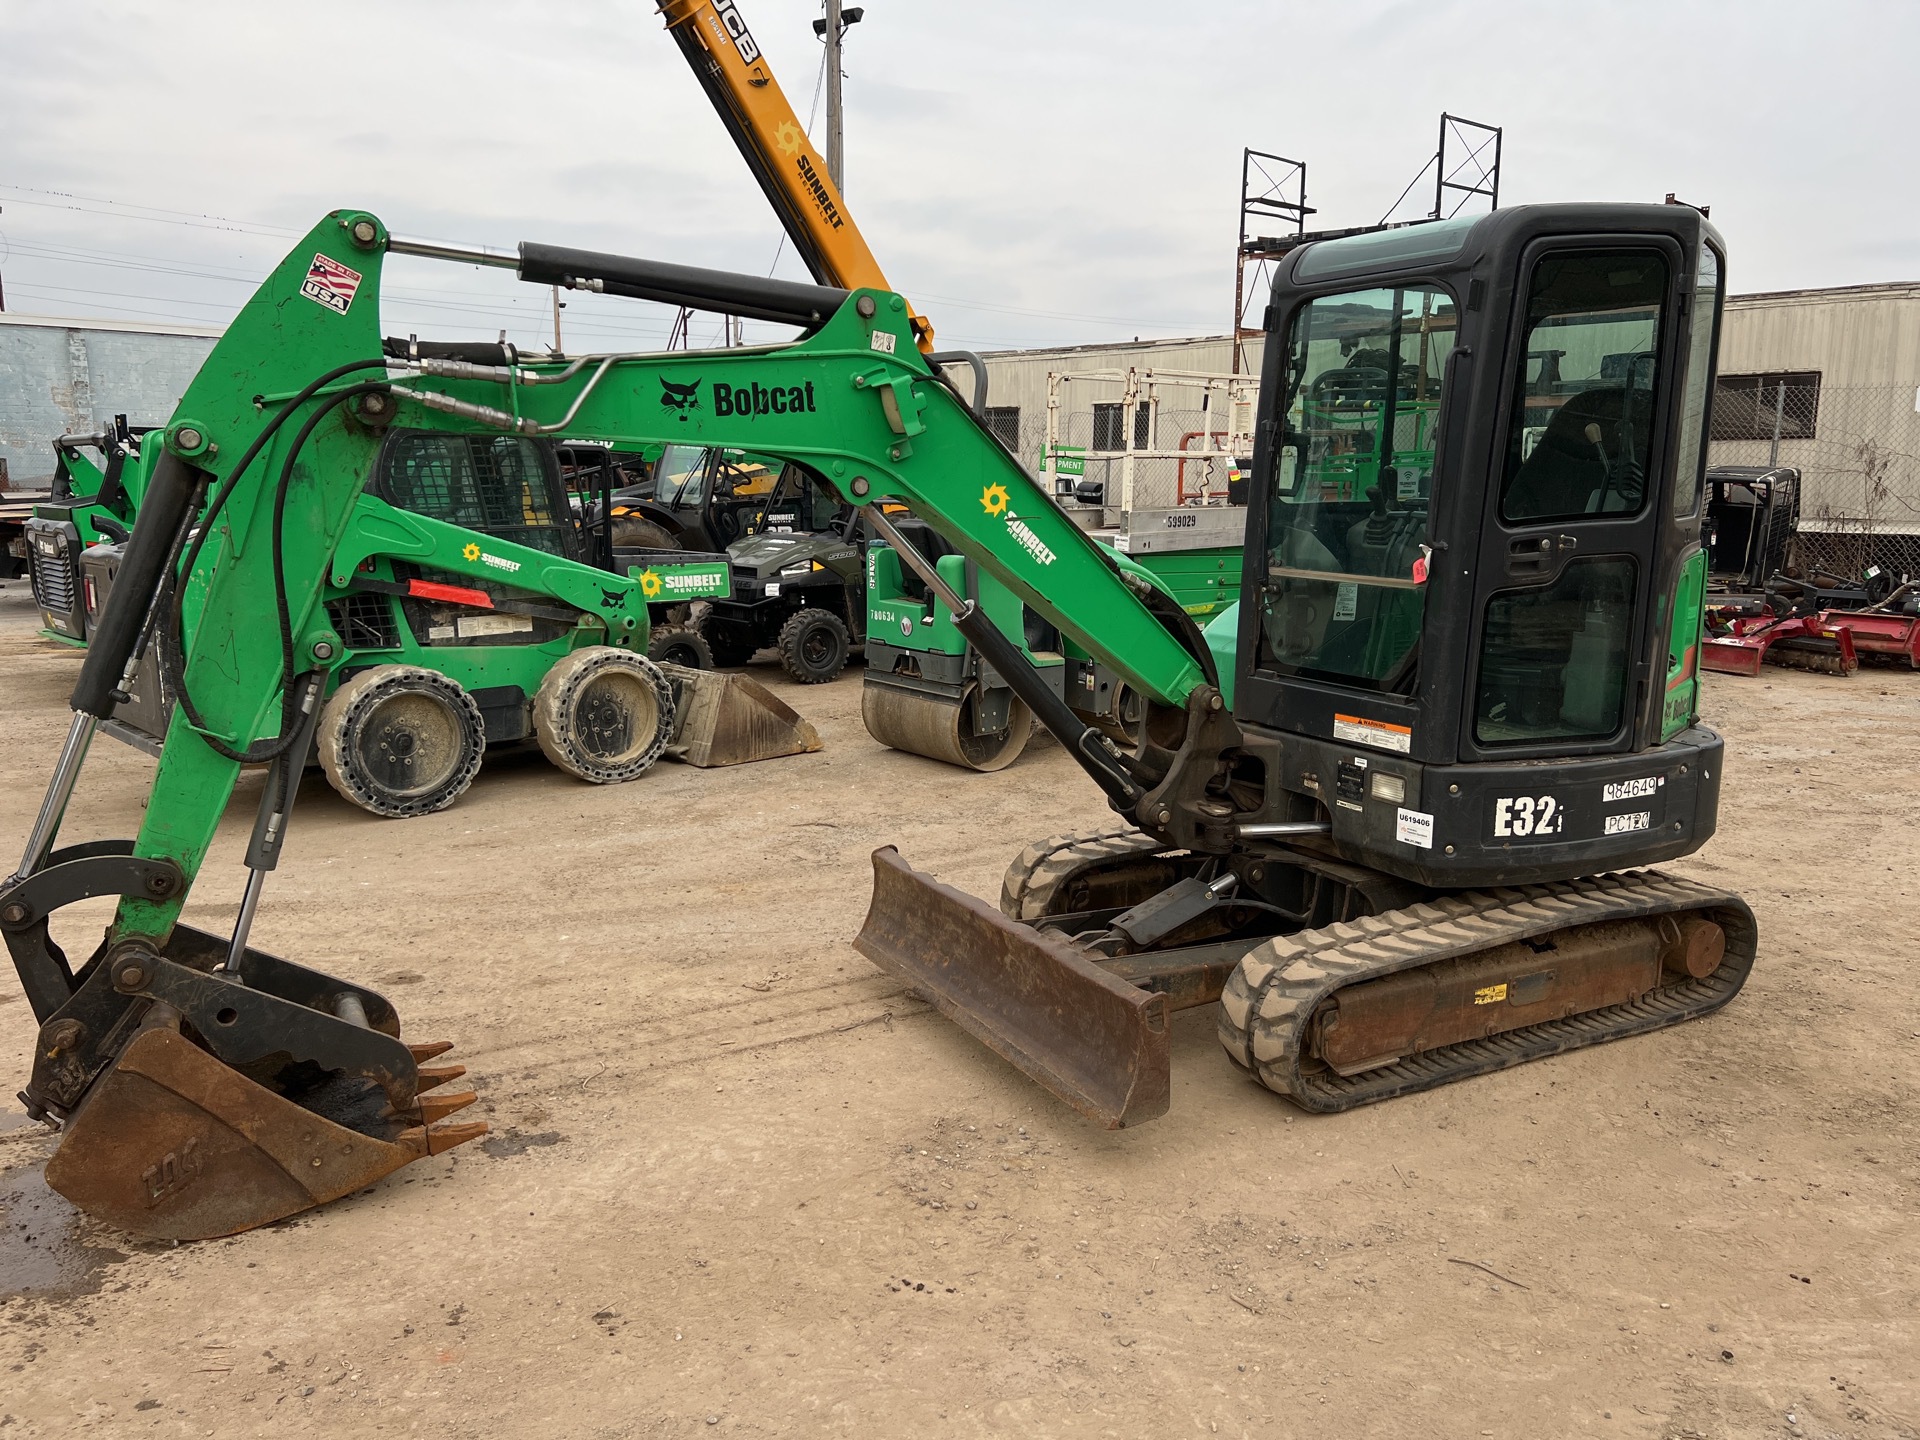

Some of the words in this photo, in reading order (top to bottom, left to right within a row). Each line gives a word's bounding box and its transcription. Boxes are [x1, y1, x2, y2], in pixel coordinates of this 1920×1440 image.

[796, 154, 844, 229] SUNBELT
[797, 171, 829, 225] RENTALS
[317, 256, 337, 269] MADE
[305, 281, 345, 310] USA
[713, 381, 816, 416] Bobcat
[1167, 515, 1197, 528] 599029
[1004, 510, 1057, 566] SUNBELT
[1006, 527, 1042, 565] RENTALS
[481, 553, 521, 571] SUNBELT
[485, 561, 514, 573] RENTALS
[665, 573, 722, 589] SUNBELT
[673, 586, 715, 594] RENTALS
[870, 609, 895, 623] 780634
[1363, 720, 1386, 729] WARNING
[1607, 777, 1656, 799] 984649
[1399, 813, 1430, 827] U619406
